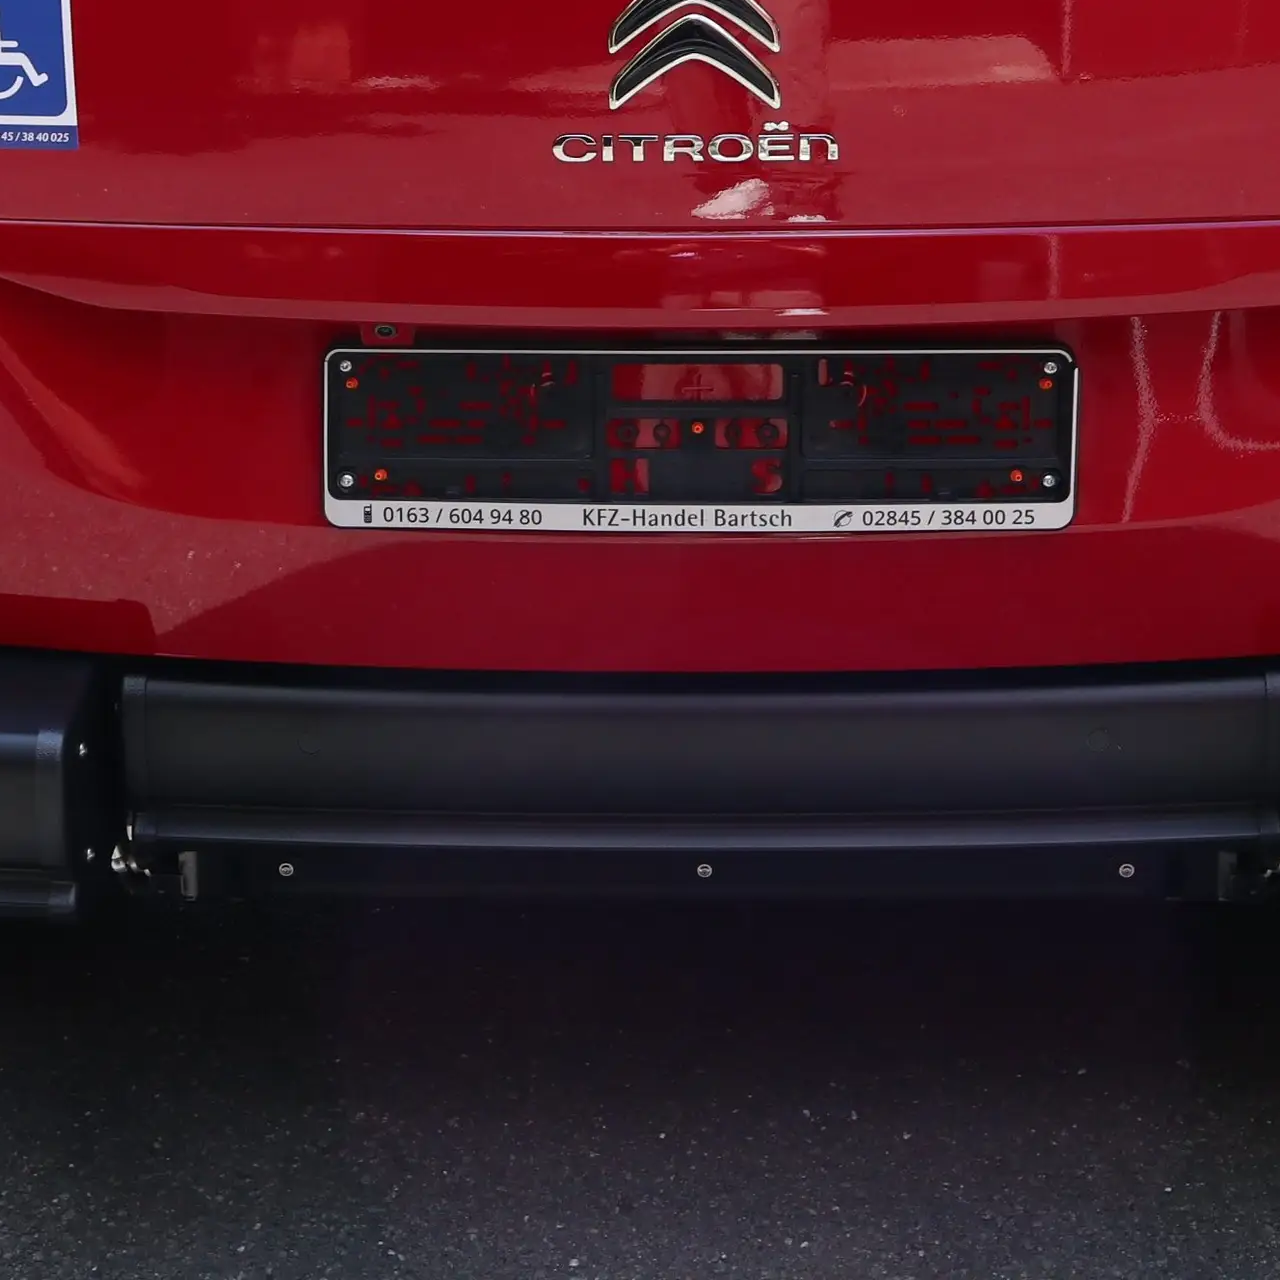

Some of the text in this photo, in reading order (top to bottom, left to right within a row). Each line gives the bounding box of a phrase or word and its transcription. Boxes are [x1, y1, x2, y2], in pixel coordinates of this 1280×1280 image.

[383, 506, 430, 524] 0163
[448, 507, 485, 525] 604
[489, 507, 514, 525] 94
[519, 508, 543, 526] 80
[582, 508, 793, 527] KFZ-Handel Bartsch
[862, 509, 922, 526] 02845
[940, 509, 976, 526] 384
[984, 509, 1007, 526] 00
[1011, 508, 1036, 525] 25
